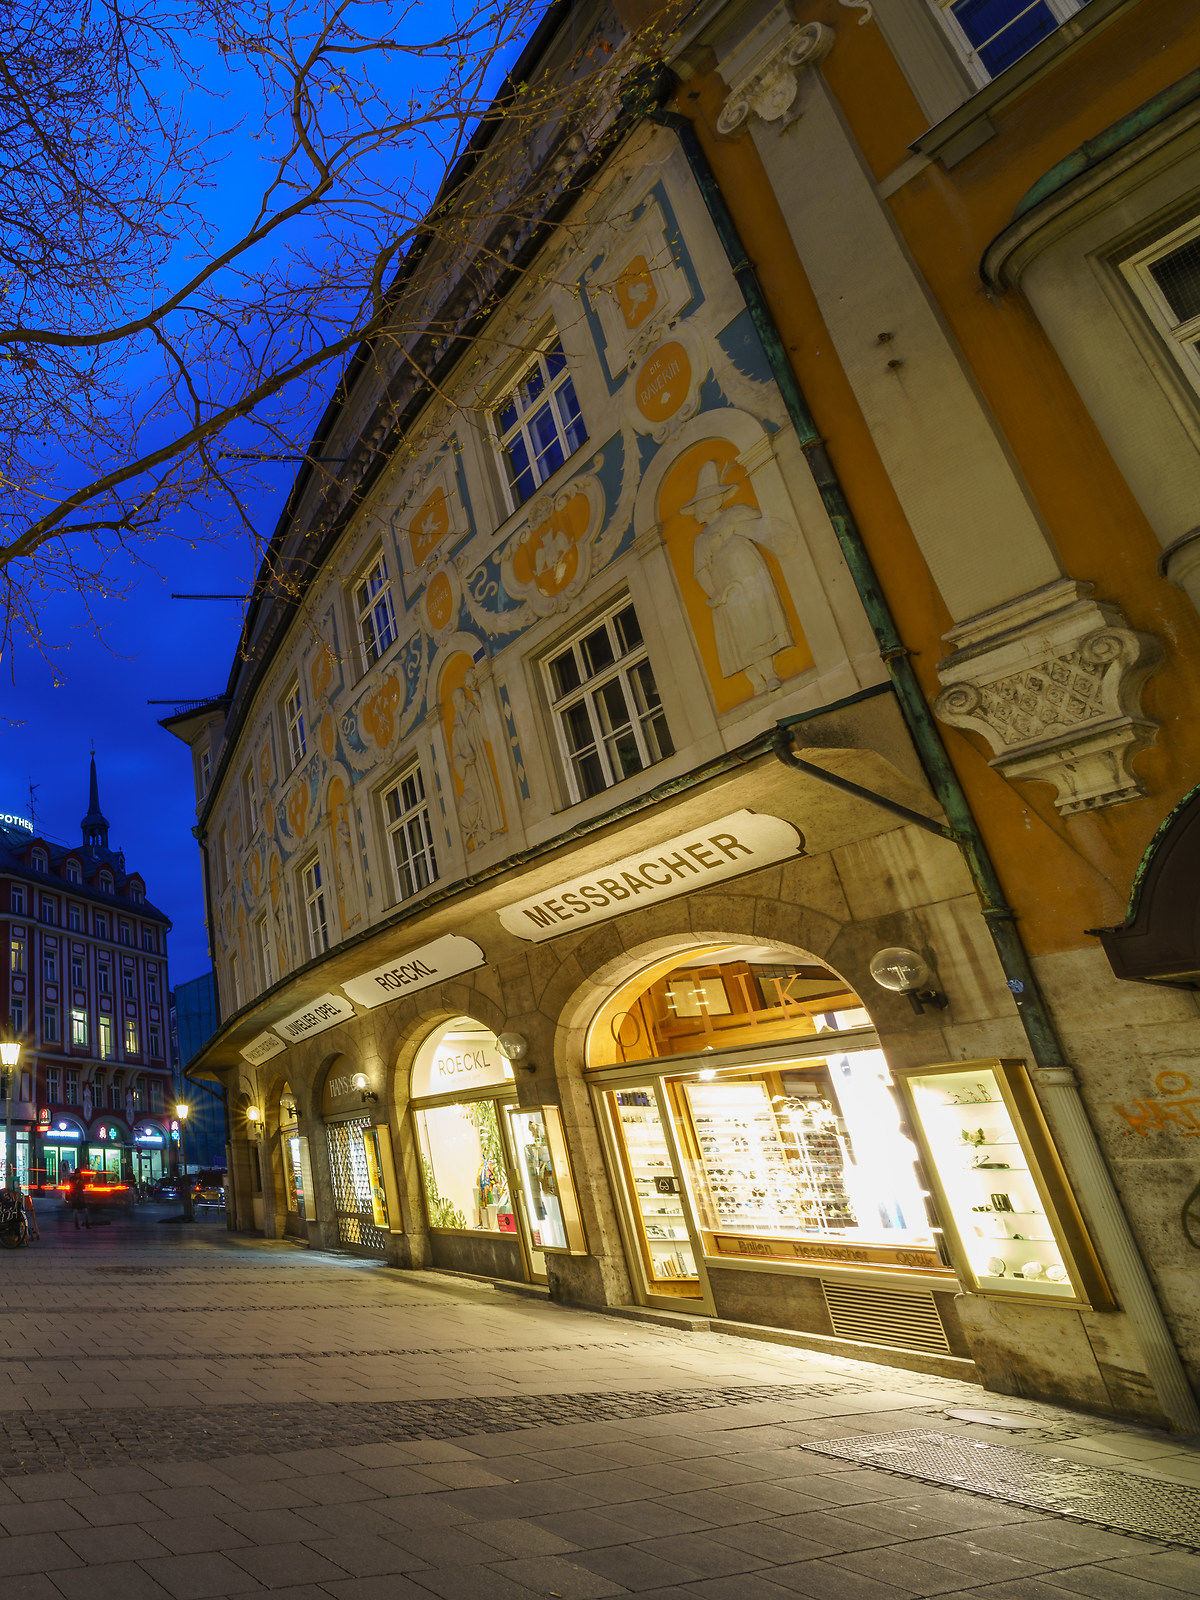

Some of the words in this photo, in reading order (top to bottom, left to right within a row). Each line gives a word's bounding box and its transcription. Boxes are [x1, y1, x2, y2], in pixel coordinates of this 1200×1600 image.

[522, 833, 754, 928] MESSBACHER
[374, 960, 438, 991] ROECKL
[284, 1012, 322, 1037] JUWELIER
[315, 1002, 342, 1020] OPEL
[438, 1050, 490, 1075] ROECKL
[329, 1076, 348, 1097] HANS
